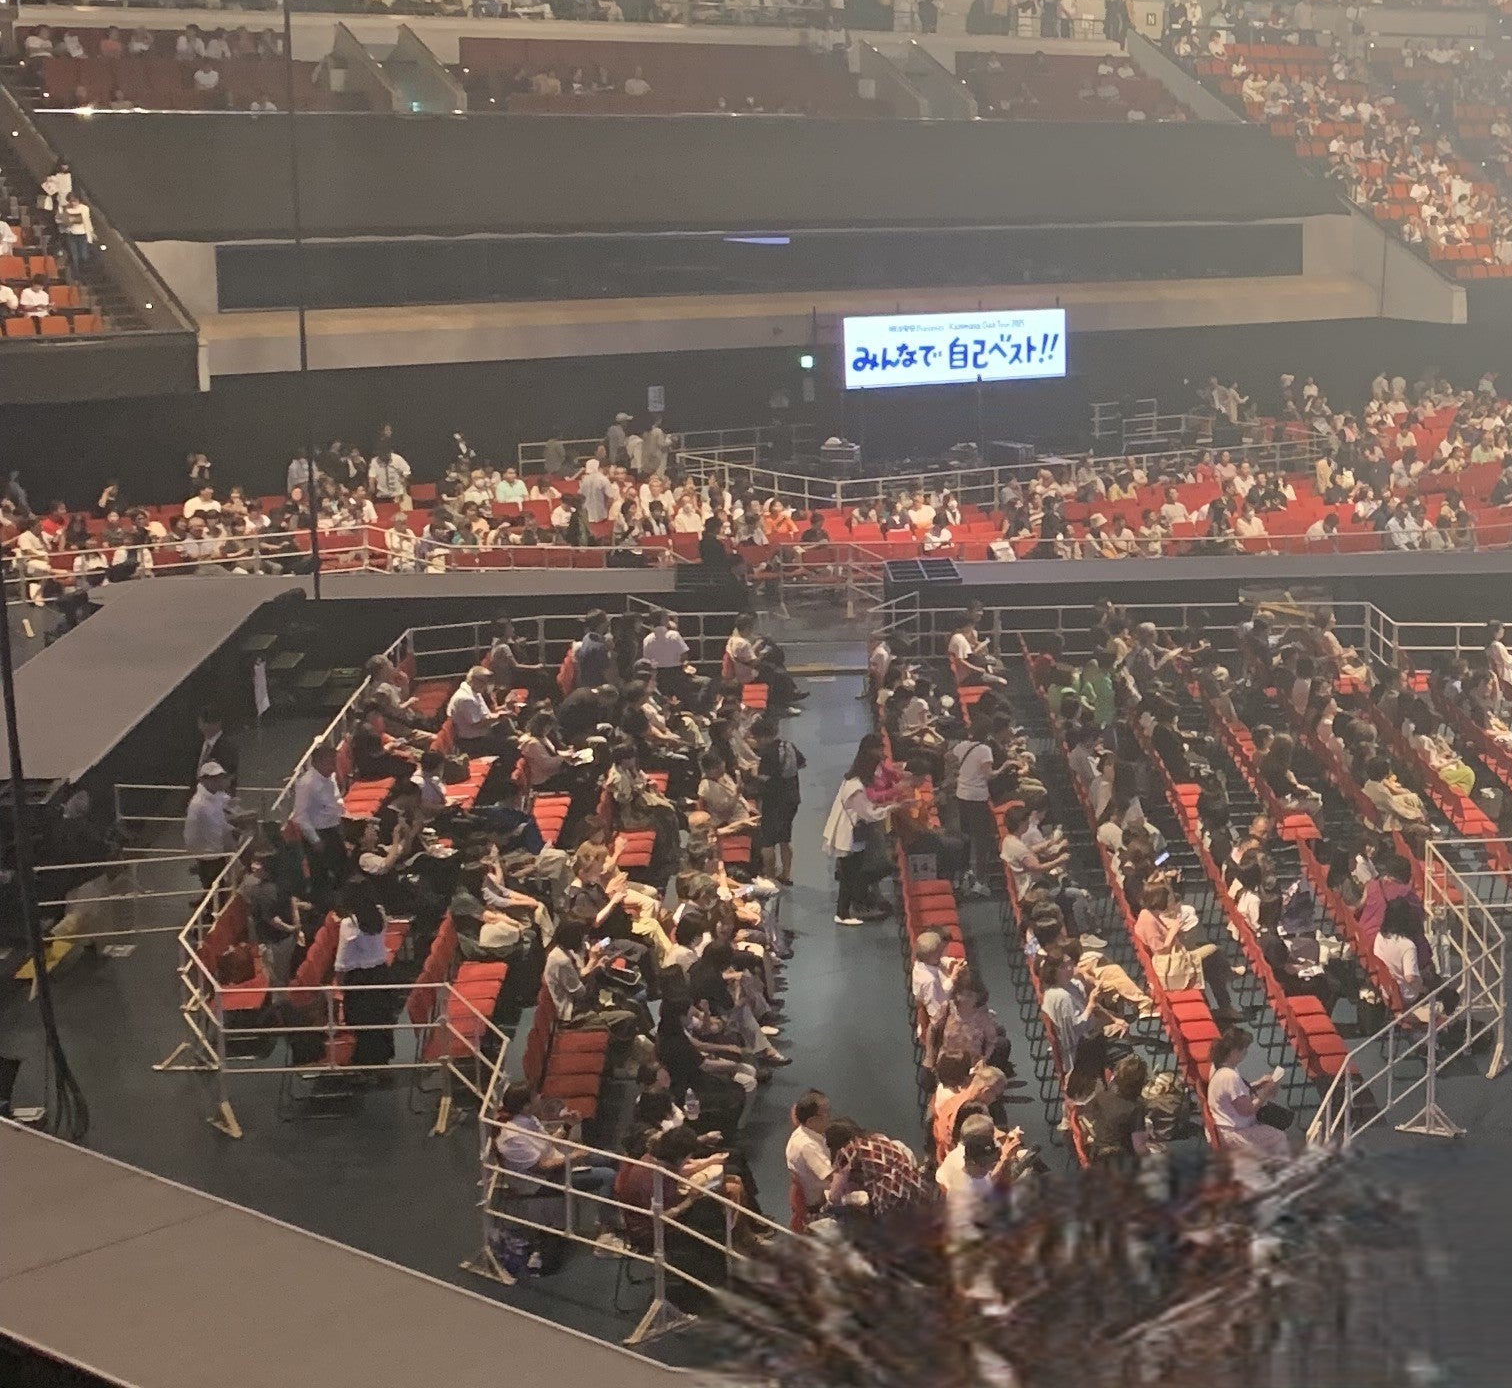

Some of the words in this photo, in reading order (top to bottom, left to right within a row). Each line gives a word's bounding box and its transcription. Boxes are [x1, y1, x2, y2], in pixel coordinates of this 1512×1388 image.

[852, 342, 943, 372] みんなで
[949, 333, 1059, 370] 自己ベスト!!
